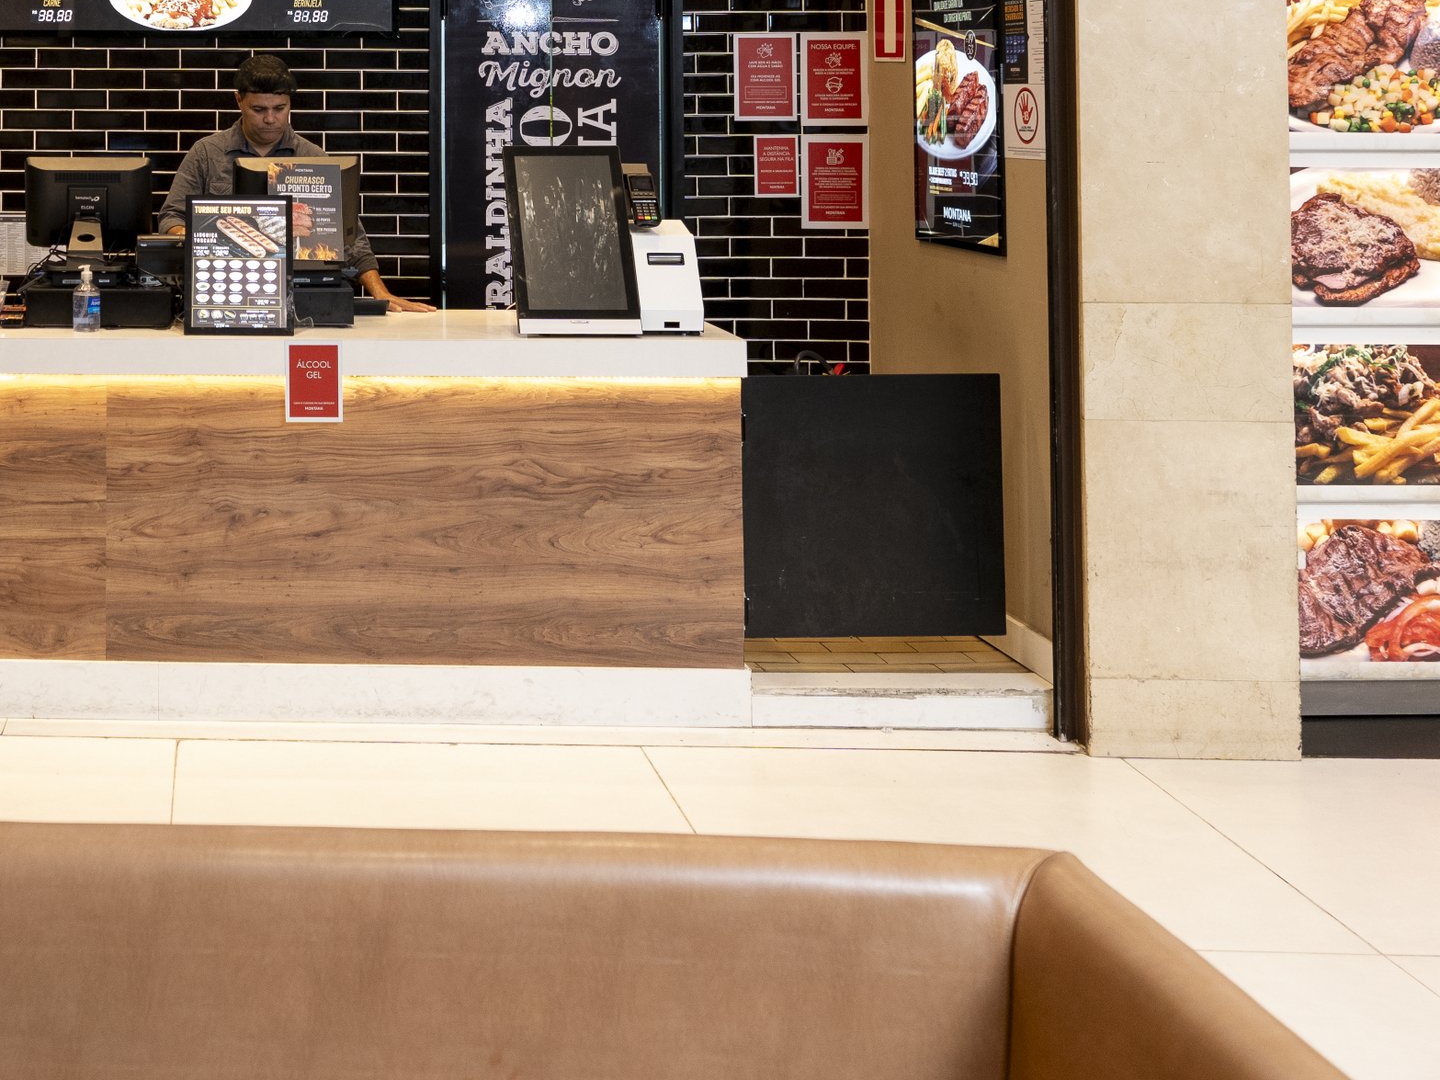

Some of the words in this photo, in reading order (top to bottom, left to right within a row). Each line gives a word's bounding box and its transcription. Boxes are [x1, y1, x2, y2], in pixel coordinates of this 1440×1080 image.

[294, 0, 322, 8] BERINJELA
[481, 31, 620, 56] ANCHO
[478, 60, 622, 99] Mignon
[285, 176, 325, 185] CHURRASCO
[277, 184, 286, 192] NO
[288, 184, 310, 193] PONTO
[311, 185, 333, 194] CERTO
[486, 97, 514, 310] RALDINHA
[195, 206, 220, 214] TURBINE
[220, 206, 232, 214] SEU
[233, 206, 252, 214] PRATO
[943, 207, 972, 223] MONTANA
[296, 359, 332, 369] ÁLCOOL
[306, 371, 322, 379] GEL
